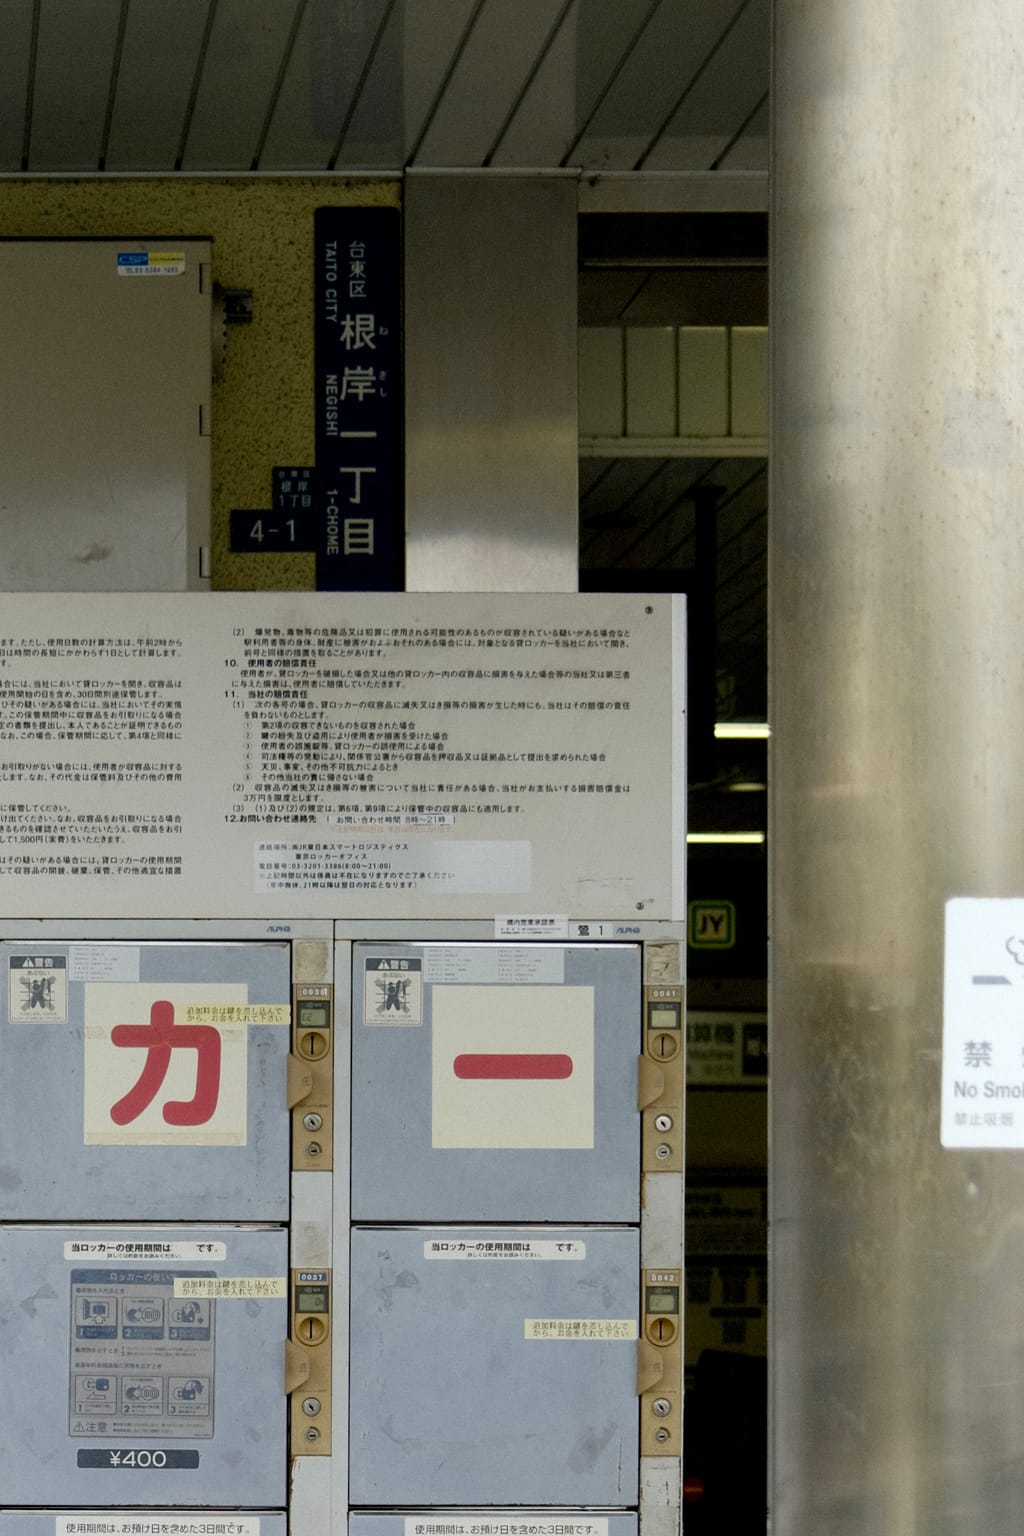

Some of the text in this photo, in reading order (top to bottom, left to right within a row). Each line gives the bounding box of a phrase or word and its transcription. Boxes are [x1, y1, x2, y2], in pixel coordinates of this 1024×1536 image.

[349, 241, 367, 297] 台東区
[326, 242, 337, 322] TAITO CITY
[326, 375, 338, 435] NEGISHI
[340, 314, 377, 554] 根岸一丁目
[281, 481, 307, 492] 根岸
[280, 495, 311, 507] 1丁目
[327, 490, 339, 554] 1-CHOME
[250, 520, 294, 541] 4-1
[248, 659, 317, 667] 使用者の賠償責任
[248, 690, 308, 699] 当社の賠償責任
[698, 914, 723, 934] JY
[390, 960, 409, 969] 警告
[110, 1000, 221, 1126] カ
[954, 1081, 978, 1098] No
[72, 1243, 220, 1252] 当ロッカーの使用期間は です。
[432, 1243, 579, 1251] 当ロッカーの使用期間は です。
[110, 1273, 177, 1282] ロッカーの使い
[86, 1422, 107, 1432] 注意
[108, 1449, 166, 1469] ¥400
[66, 1523, 251, 1534] 使用期間は、お預け日を含めた3日間です。
[415, 1525, 599, 1535] 使用期間は、お預け日を含めた3日間です。
